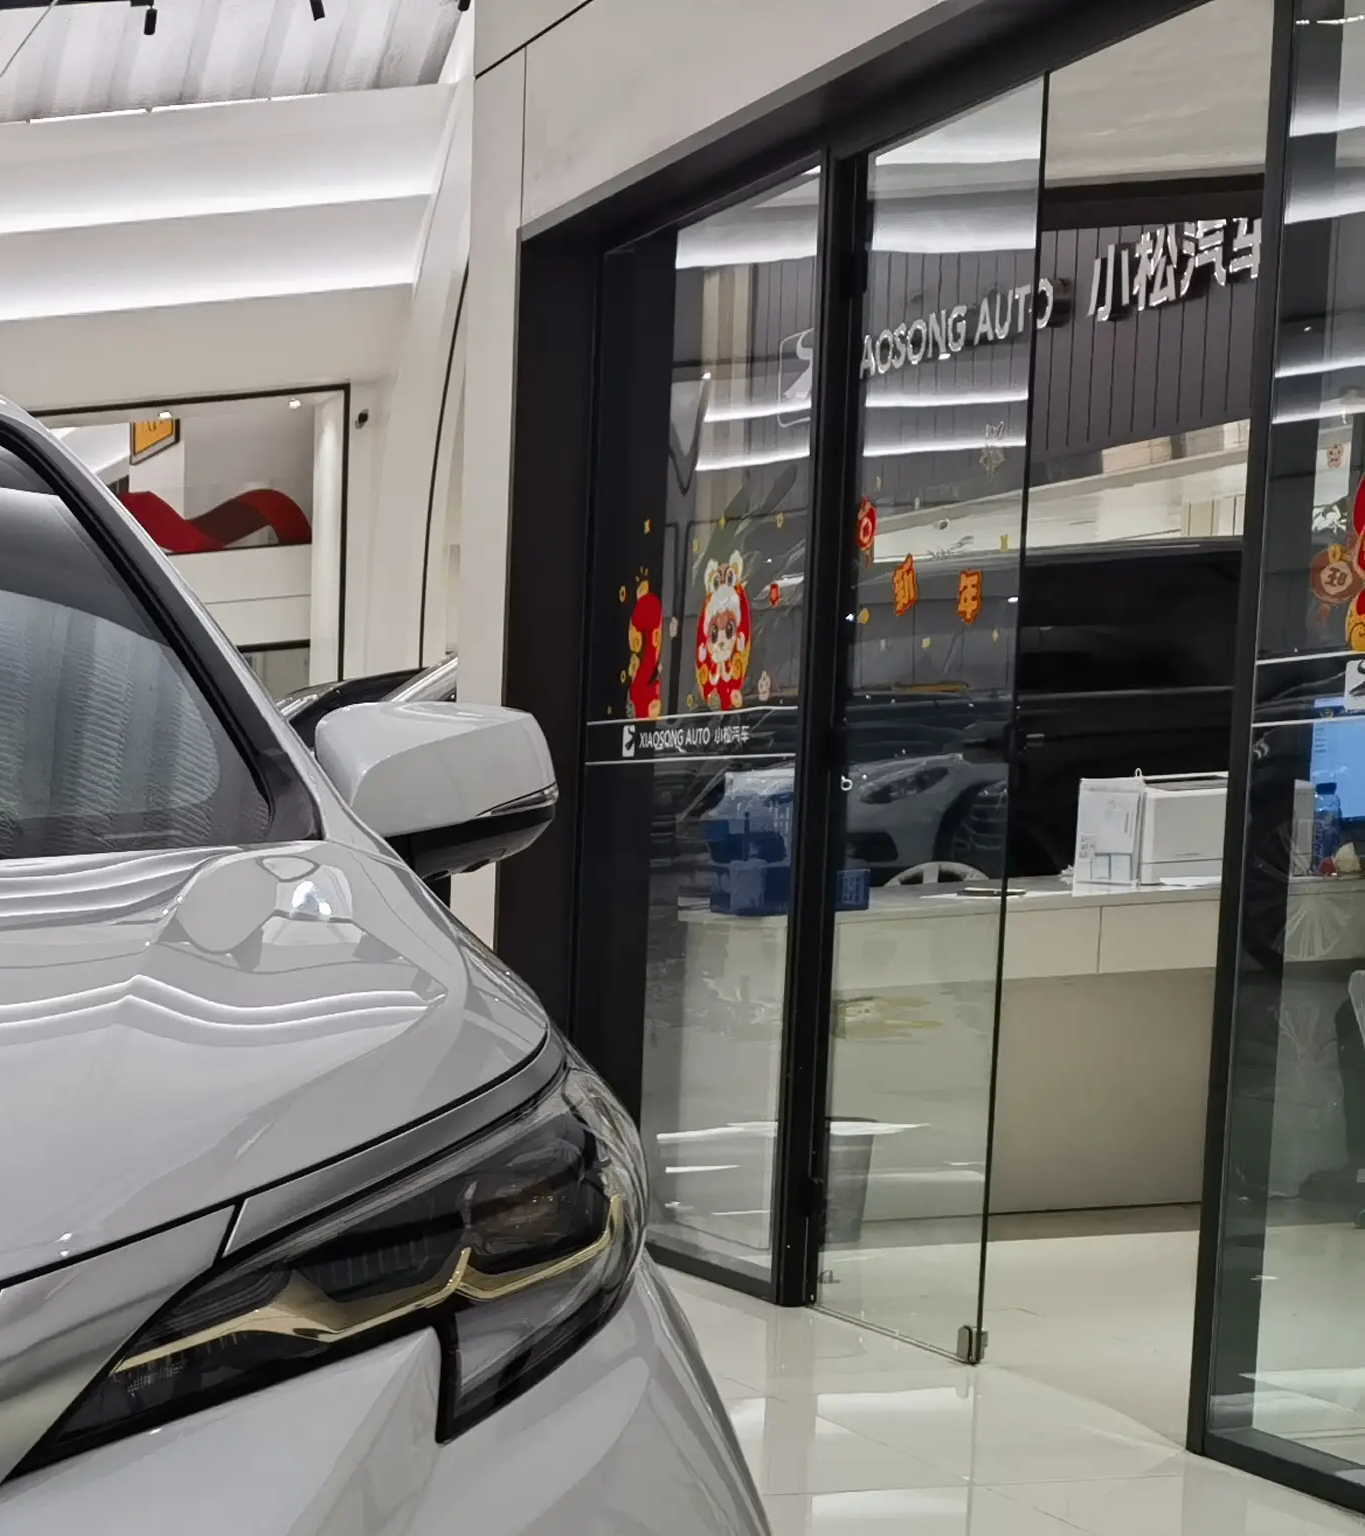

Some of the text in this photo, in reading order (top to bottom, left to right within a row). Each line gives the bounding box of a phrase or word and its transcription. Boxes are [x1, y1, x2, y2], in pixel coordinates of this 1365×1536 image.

[859, 304, 967, 379] AOSONG
[973, 277, 1054, 346] AUTO
[638, 725, 751, 749] XIAOSONG AUTO 小松汽车
